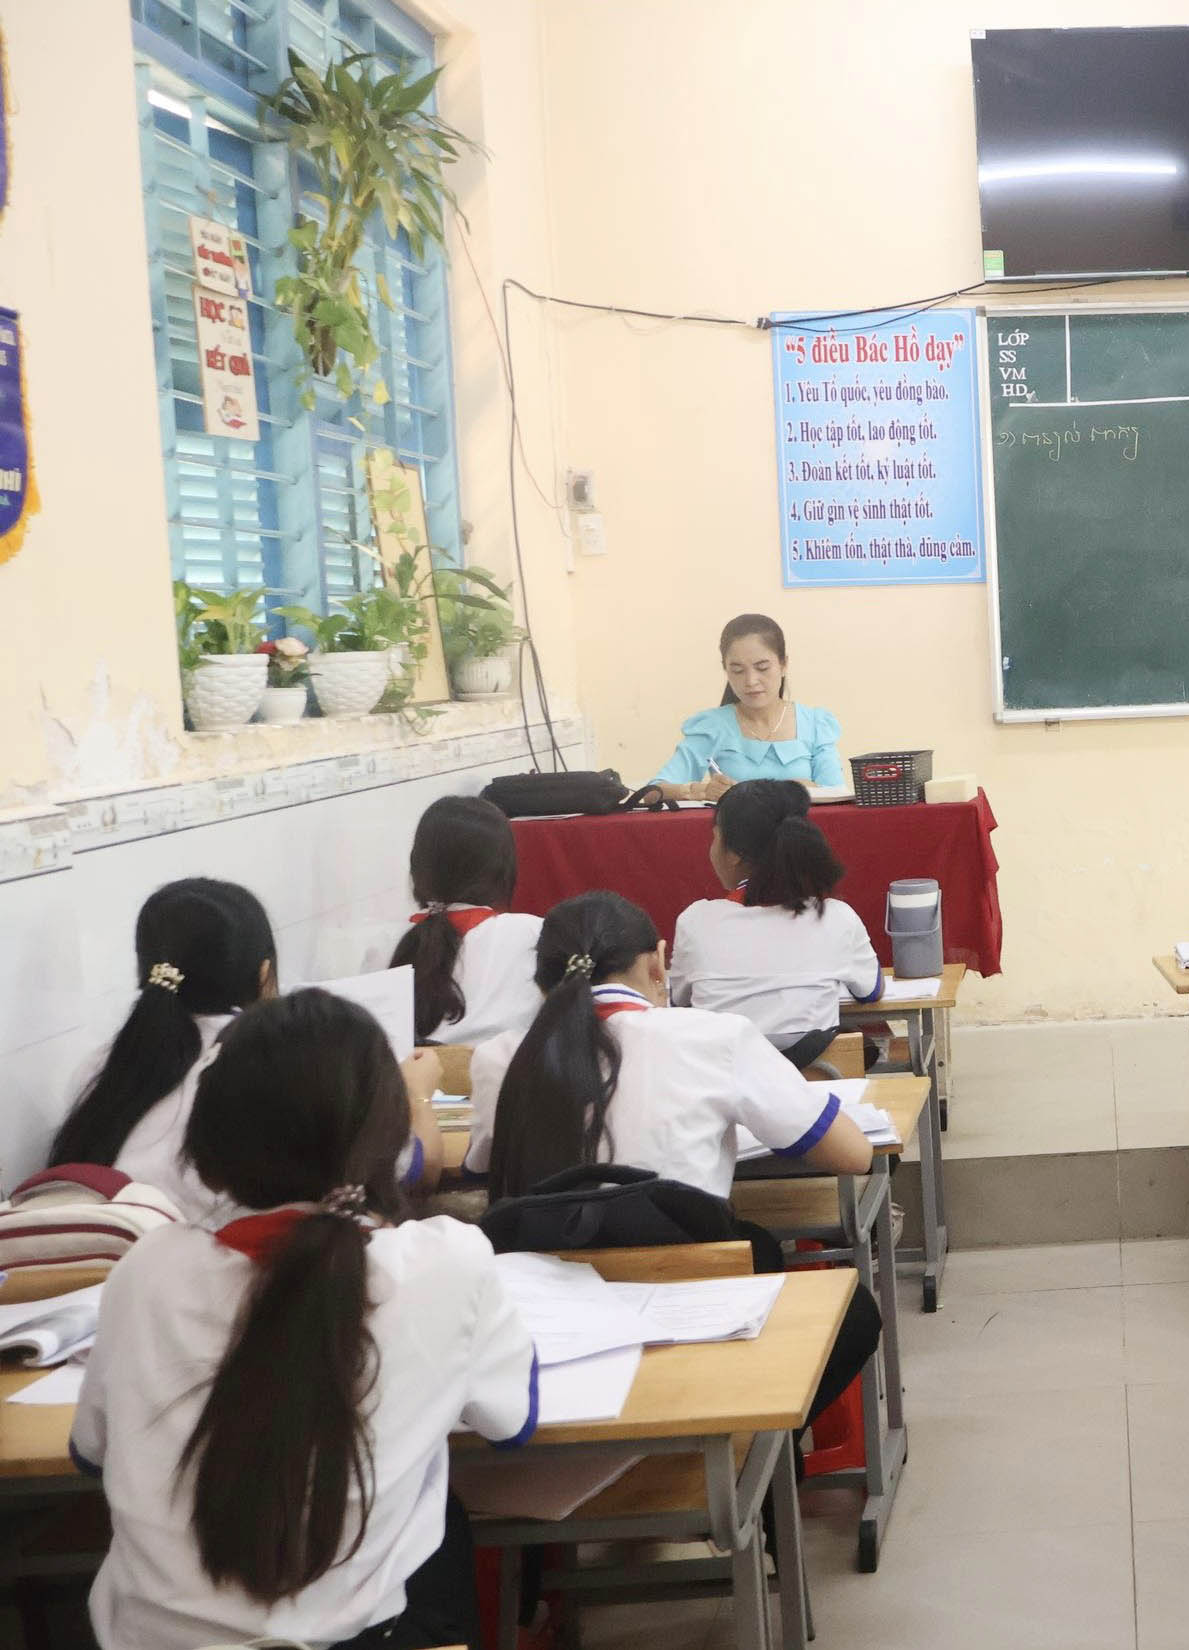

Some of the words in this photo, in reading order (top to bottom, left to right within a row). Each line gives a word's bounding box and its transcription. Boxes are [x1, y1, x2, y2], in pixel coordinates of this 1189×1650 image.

[811, 328, 850, 363] điều
[855, 334, 888, 363] Bác
[894, 325, 920, 362] Hồ
[998, 329, 1030, 346] LỚP
[999, 351, 1017, 363] SS
[999, 367, 1027, 380] VM
[786, 382, 795, 403] 1.
[797, 381, 820, 402] Yêu
[823, 375, 838, 401] Tổ
[873, 380, 892, 406] yêu
[896, 374, 923, 405] đồng
[926, 379, 949, 401] bào.
[1001, 383, 1028, 397] HD
[787, 421, 797, 443] 2.
[800, 421, 823, 448] Học
[826, 420, 843, 448] tập
[868, 420, 885, 441] lao
[888, 419, 916, 447] động
[919, 413, 937, 440] tốt.
[788, 461, 799, 481] 3.
[801, 459, 832, 481] Đoàn
[835, 454, 852, 481] kết
[893, 458, 915, 486] luật
[918, 452, 936, 479] tốt.
[790, 501, 801, 521] 4.
[803, 500, 825, 521] Giữ
[827, 499, 845, 525] gìn
[848, 499, 860, 527] vệ
[863, 501, 886, 520] sinh
[890, 498, 911, 525] thật
[915, 492, 933, 519] tốt.
[793, 540, 802, 560] 5.
[805, 537, 842, 560] Khiêm
[870, 536, 892, 565] thật
[919, 536, 947, 561] dũng
